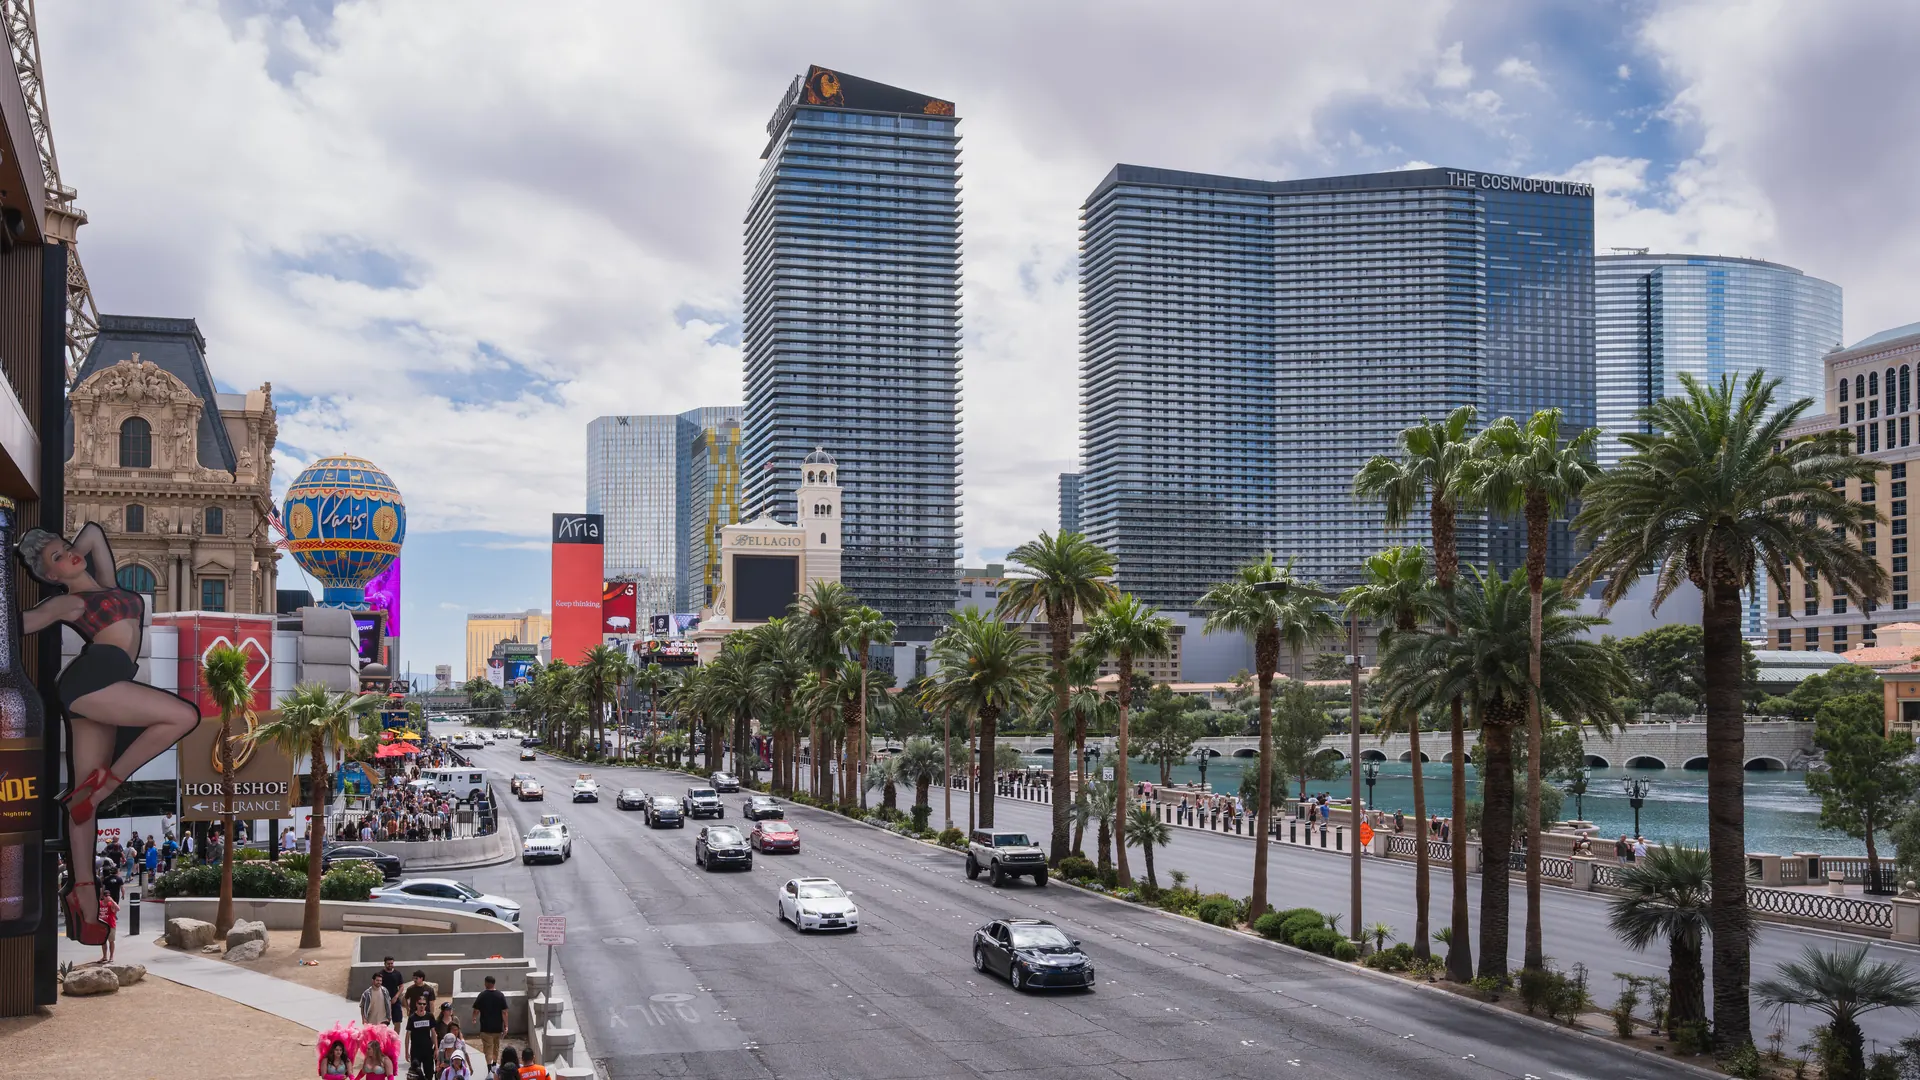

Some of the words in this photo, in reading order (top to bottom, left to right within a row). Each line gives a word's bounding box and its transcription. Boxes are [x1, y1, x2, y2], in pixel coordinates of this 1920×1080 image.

[1447, 171, 1477, 187] THE
[1481, 174, 1593, 197] COSMOPOLITAN
[317, 488, 367, 544] Paris
[558, 517, 599, 539] Aria
[731, 534, 801, 547] BELLAGIO
[555, 599, 573, 609] Keep
[185, 782, 288, 796] HORESHOE
[3, 810, 32, 818] Nightlife
[104, 828, 121, 836] CVS
